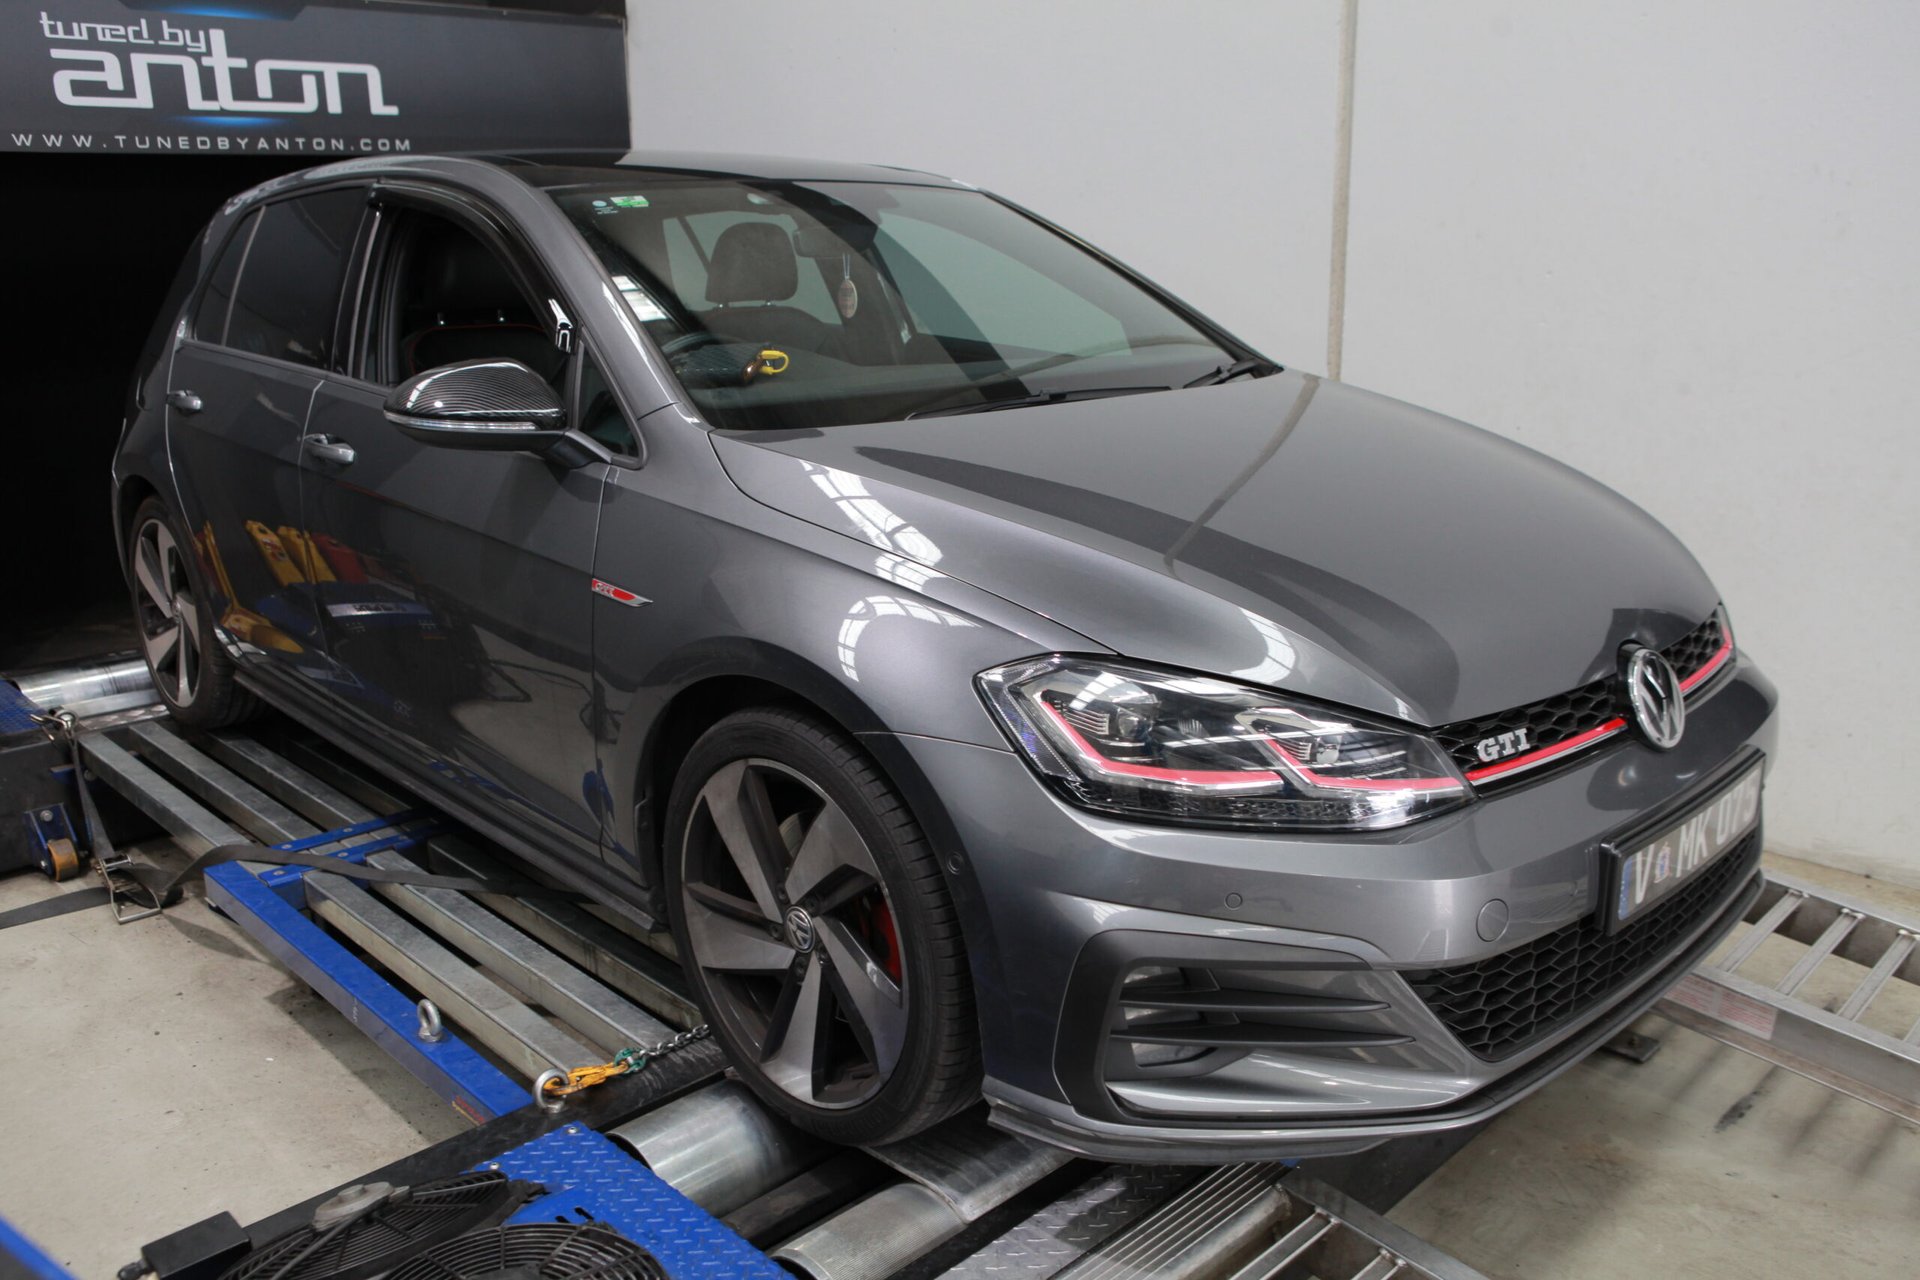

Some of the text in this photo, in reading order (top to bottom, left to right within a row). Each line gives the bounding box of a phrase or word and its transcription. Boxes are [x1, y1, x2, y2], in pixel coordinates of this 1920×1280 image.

[40, 11, 207, 52] tuned by
[50, 28, 399, 116] anton
[11, 133, 411, 151] WWW.TUNEDBYANTON.COM
[1477, 728, 1531, 762] GTI
